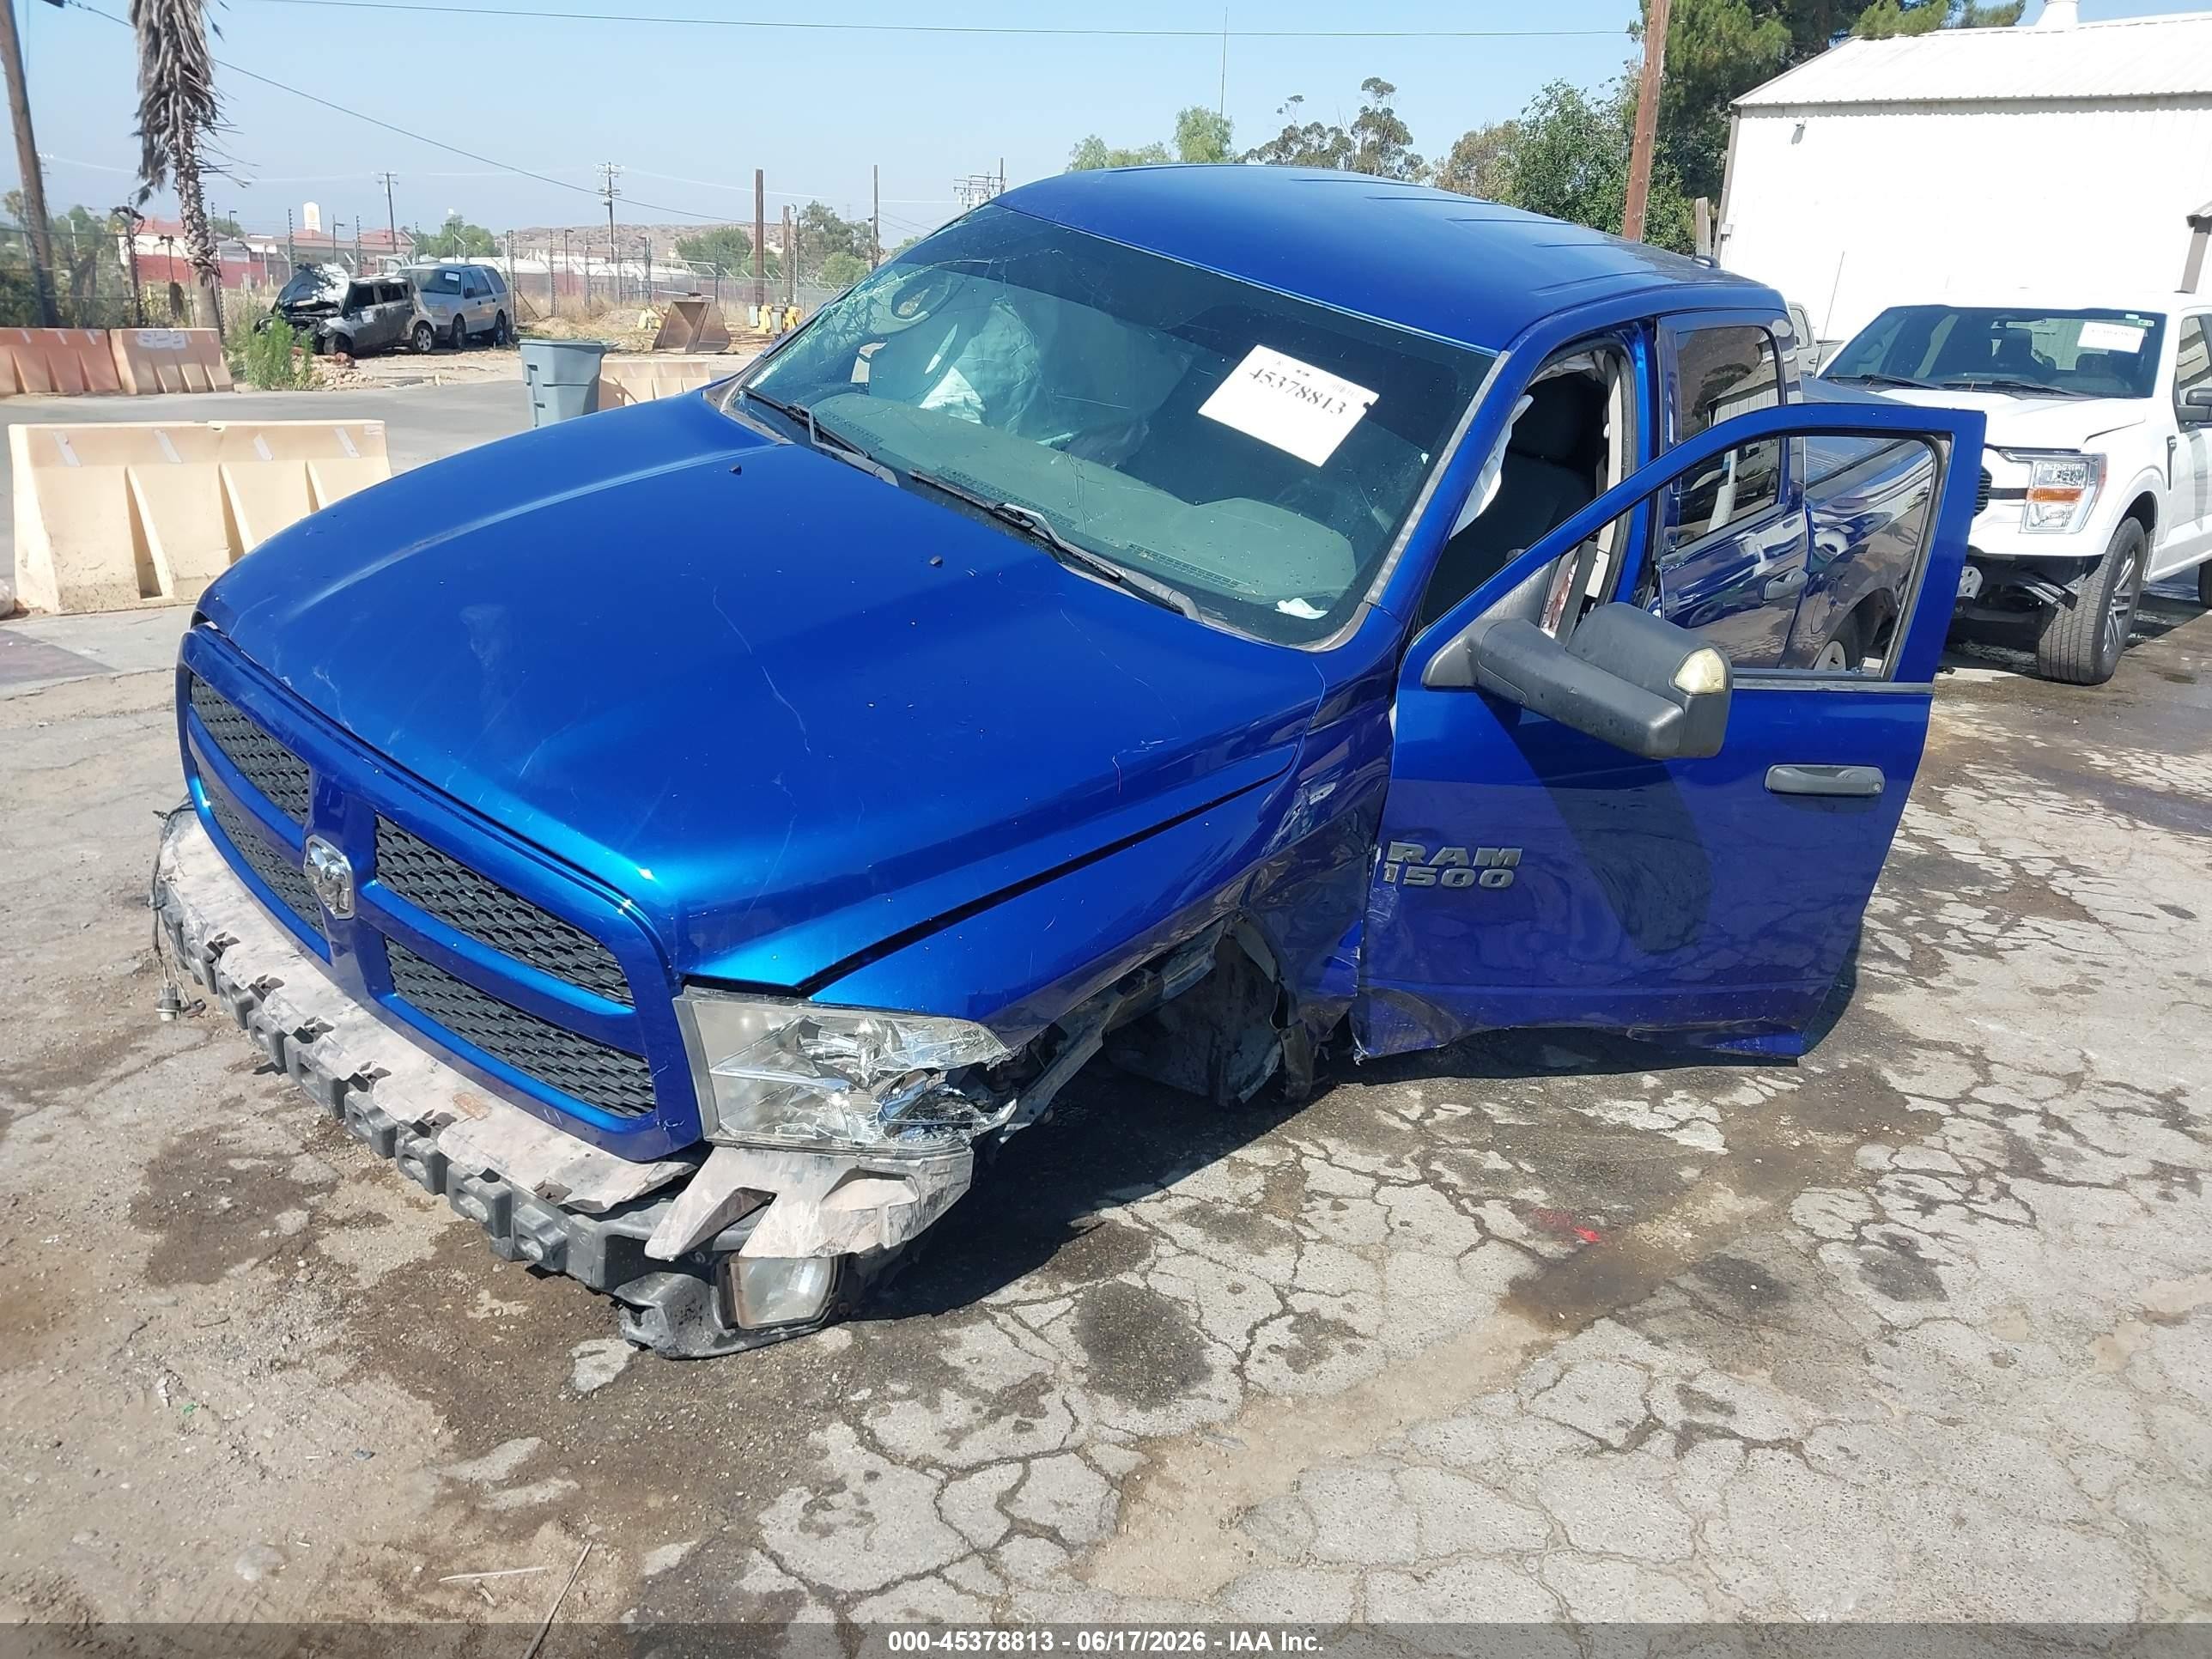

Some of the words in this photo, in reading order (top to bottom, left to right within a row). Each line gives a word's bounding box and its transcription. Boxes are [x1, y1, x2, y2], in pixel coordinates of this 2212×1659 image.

[1249, 368, 1347, 416] 45378813
[1386, 841, 1522, 866] RAM
[1382, 862, 1515, 888] 1500
